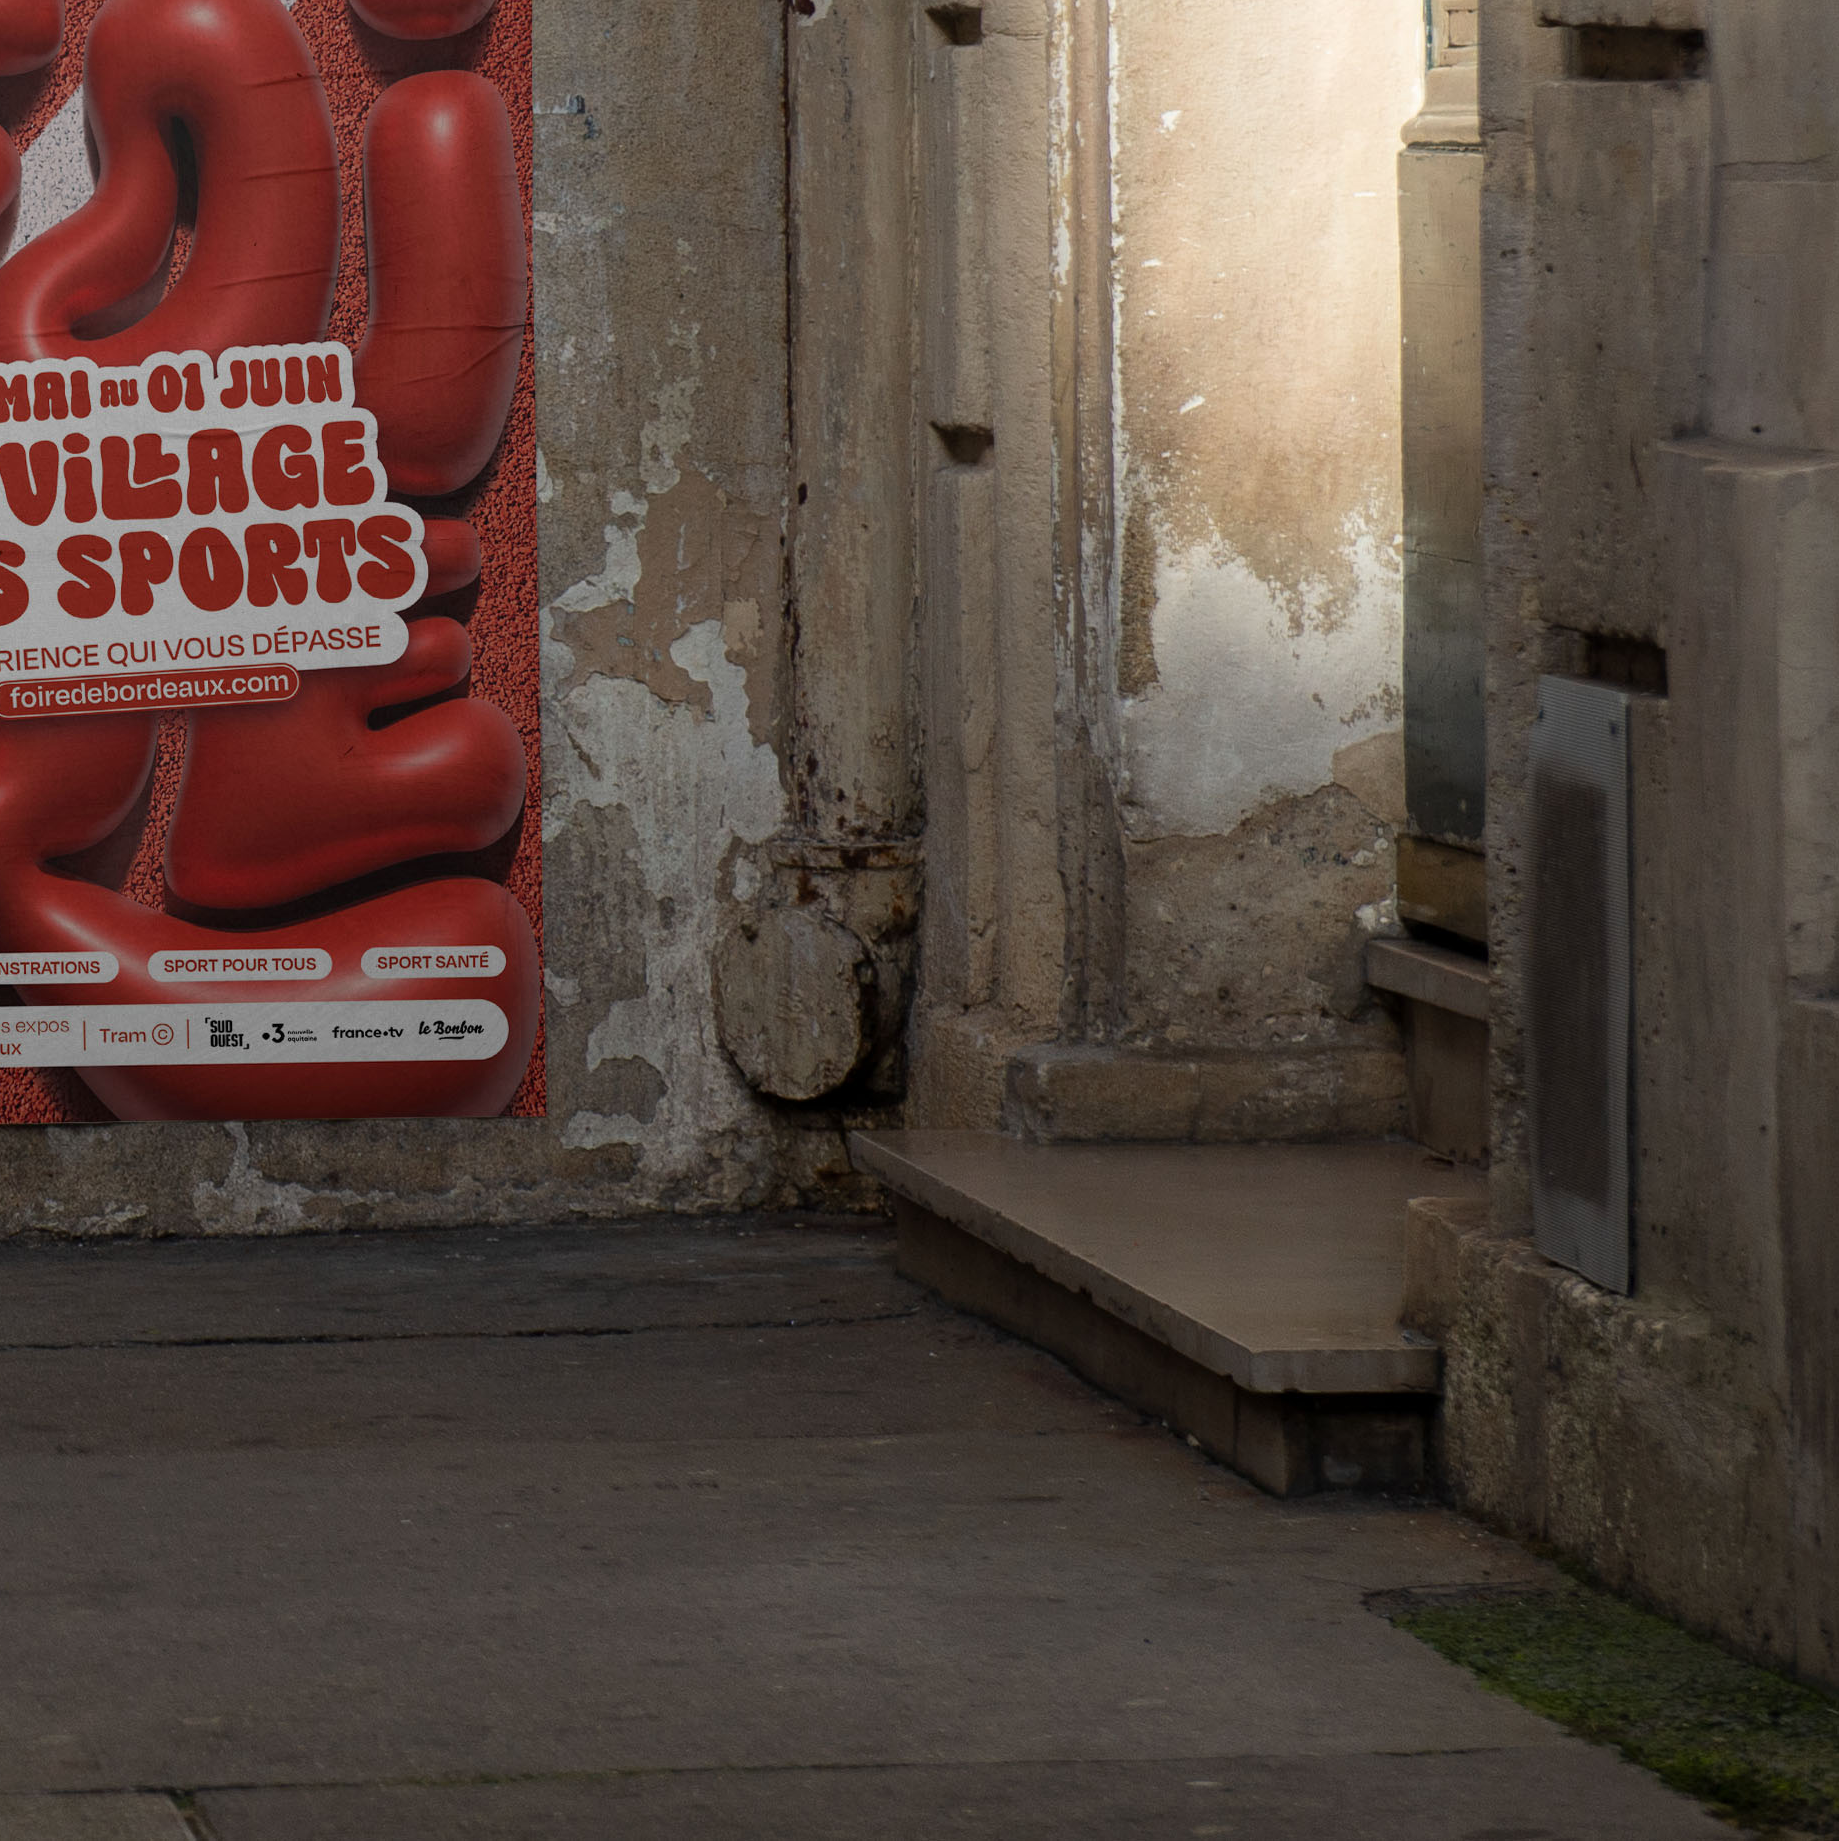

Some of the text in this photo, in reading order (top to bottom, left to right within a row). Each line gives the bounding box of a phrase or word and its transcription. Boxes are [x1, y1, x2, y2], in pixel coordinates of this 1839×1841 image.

[57, 515, 415, 619] SPORTS
[108, 641, 156, 667] QUI
[164, 635, 244, 660] VOUS
[253, 626, 381, 655] DÉPASSE
[10, 675, 288, 708] foiredebordeaux.com
[165, 958, 316, 972] SPORT POUR TOUS
[378, 951, 489, 969] SPORT SANTÉ
[16, 1021, 69, 1035] expos
[100, 1029, 146, 1042] Tram
